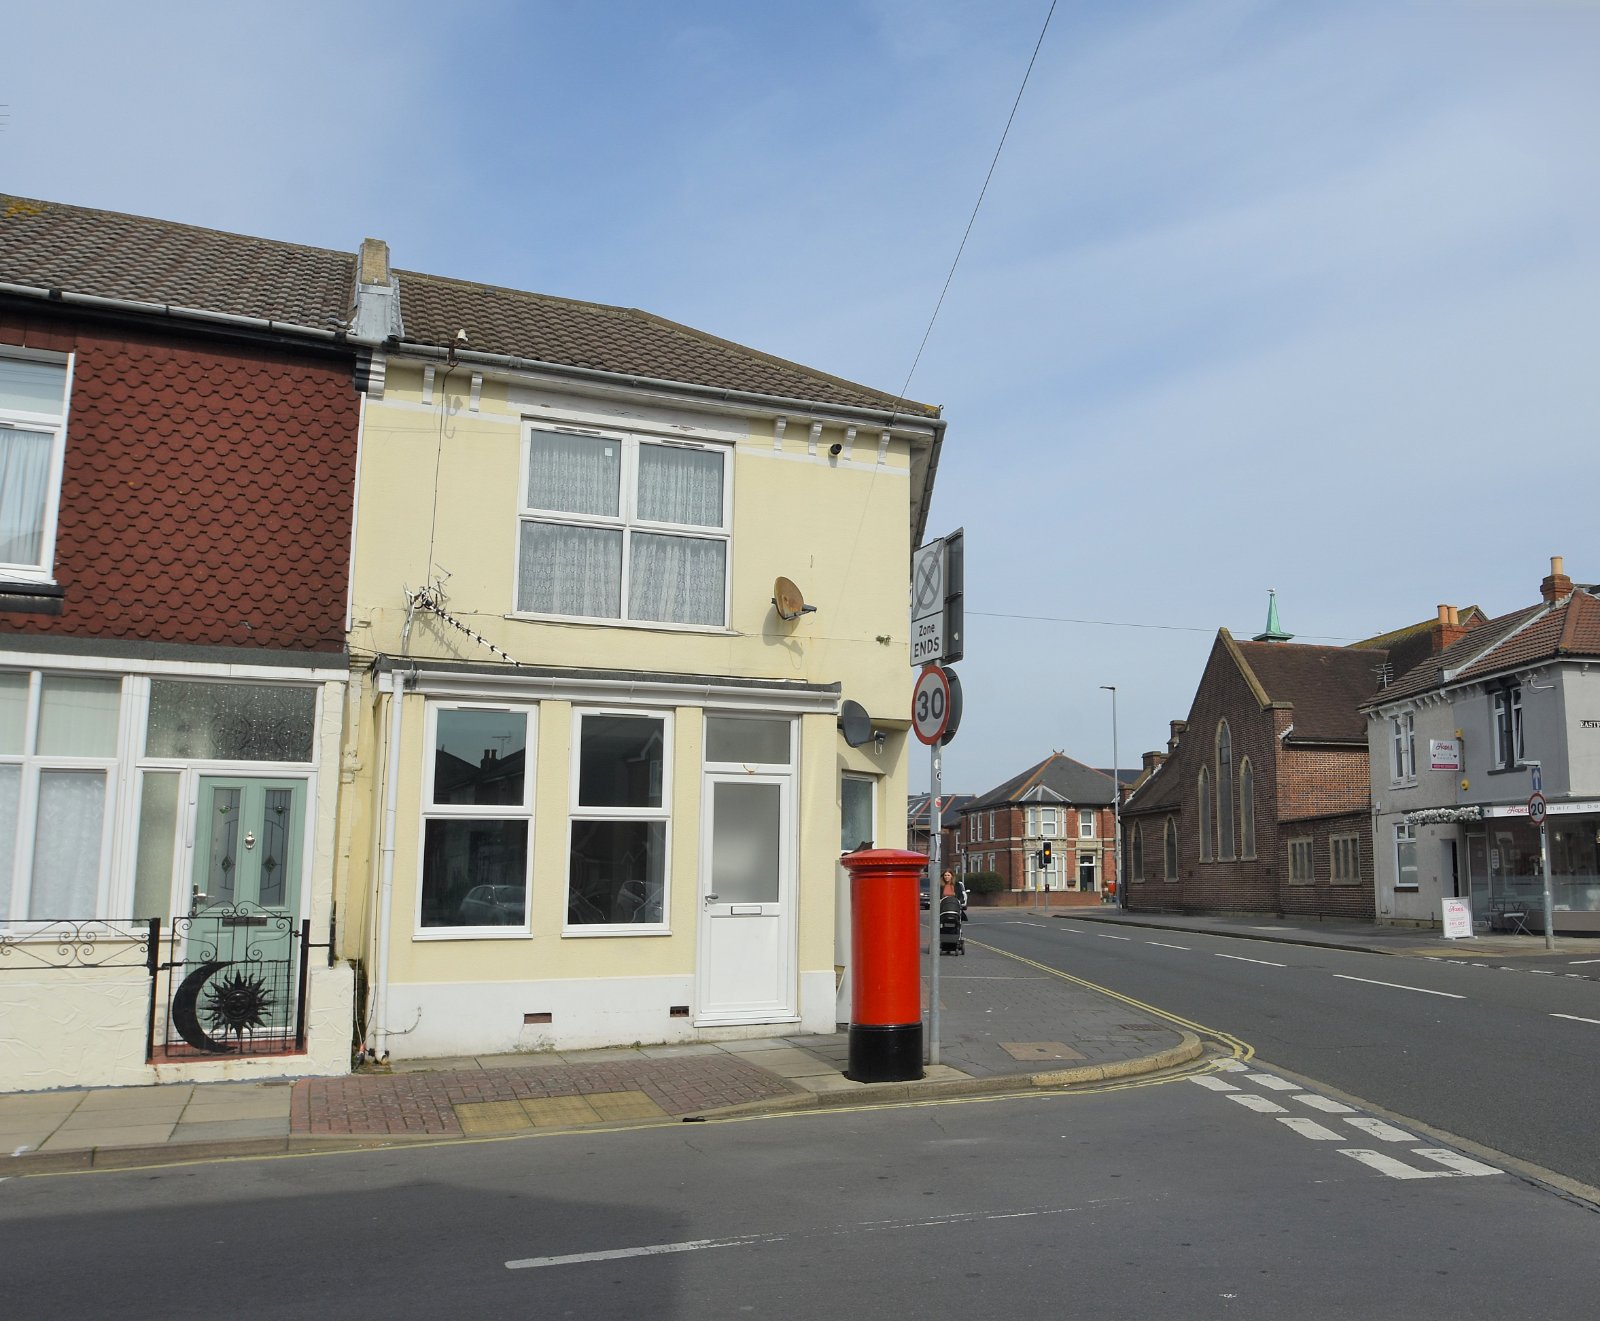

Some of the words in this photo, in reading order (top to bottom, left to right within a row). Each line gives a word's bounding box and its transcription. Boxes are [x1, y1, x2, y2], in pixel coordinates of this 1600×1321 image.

[919, 624, 936, 637] Zone
[914, 637, 939, 657] ENDS
[917, 688, 943, 722] 30
[1530, 802, 1544, 815] 20
